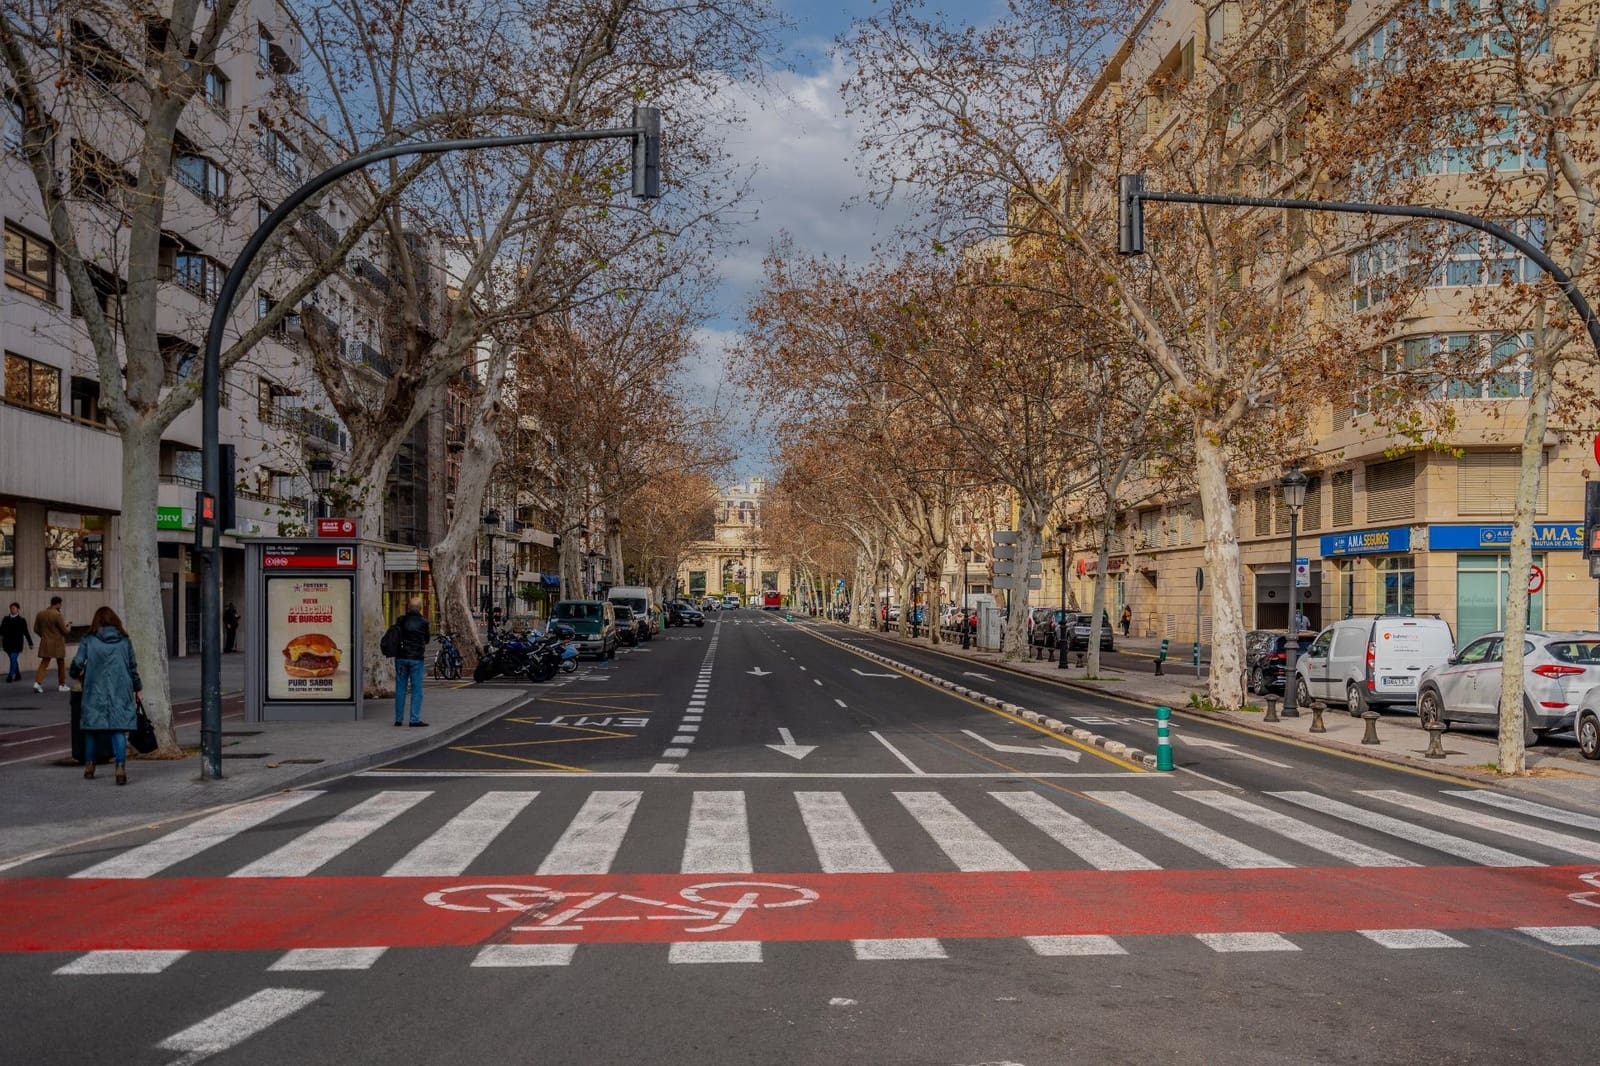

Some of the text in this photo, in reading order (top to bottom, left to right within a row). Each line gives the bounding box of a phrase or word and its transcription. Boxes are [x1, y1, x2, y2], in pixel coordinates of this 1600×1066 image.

[157, 514, 179, 522] DKV
[288, 615, 333, 623] DE BURGERS
[288, 679, 333, 687] PURO SABOR
